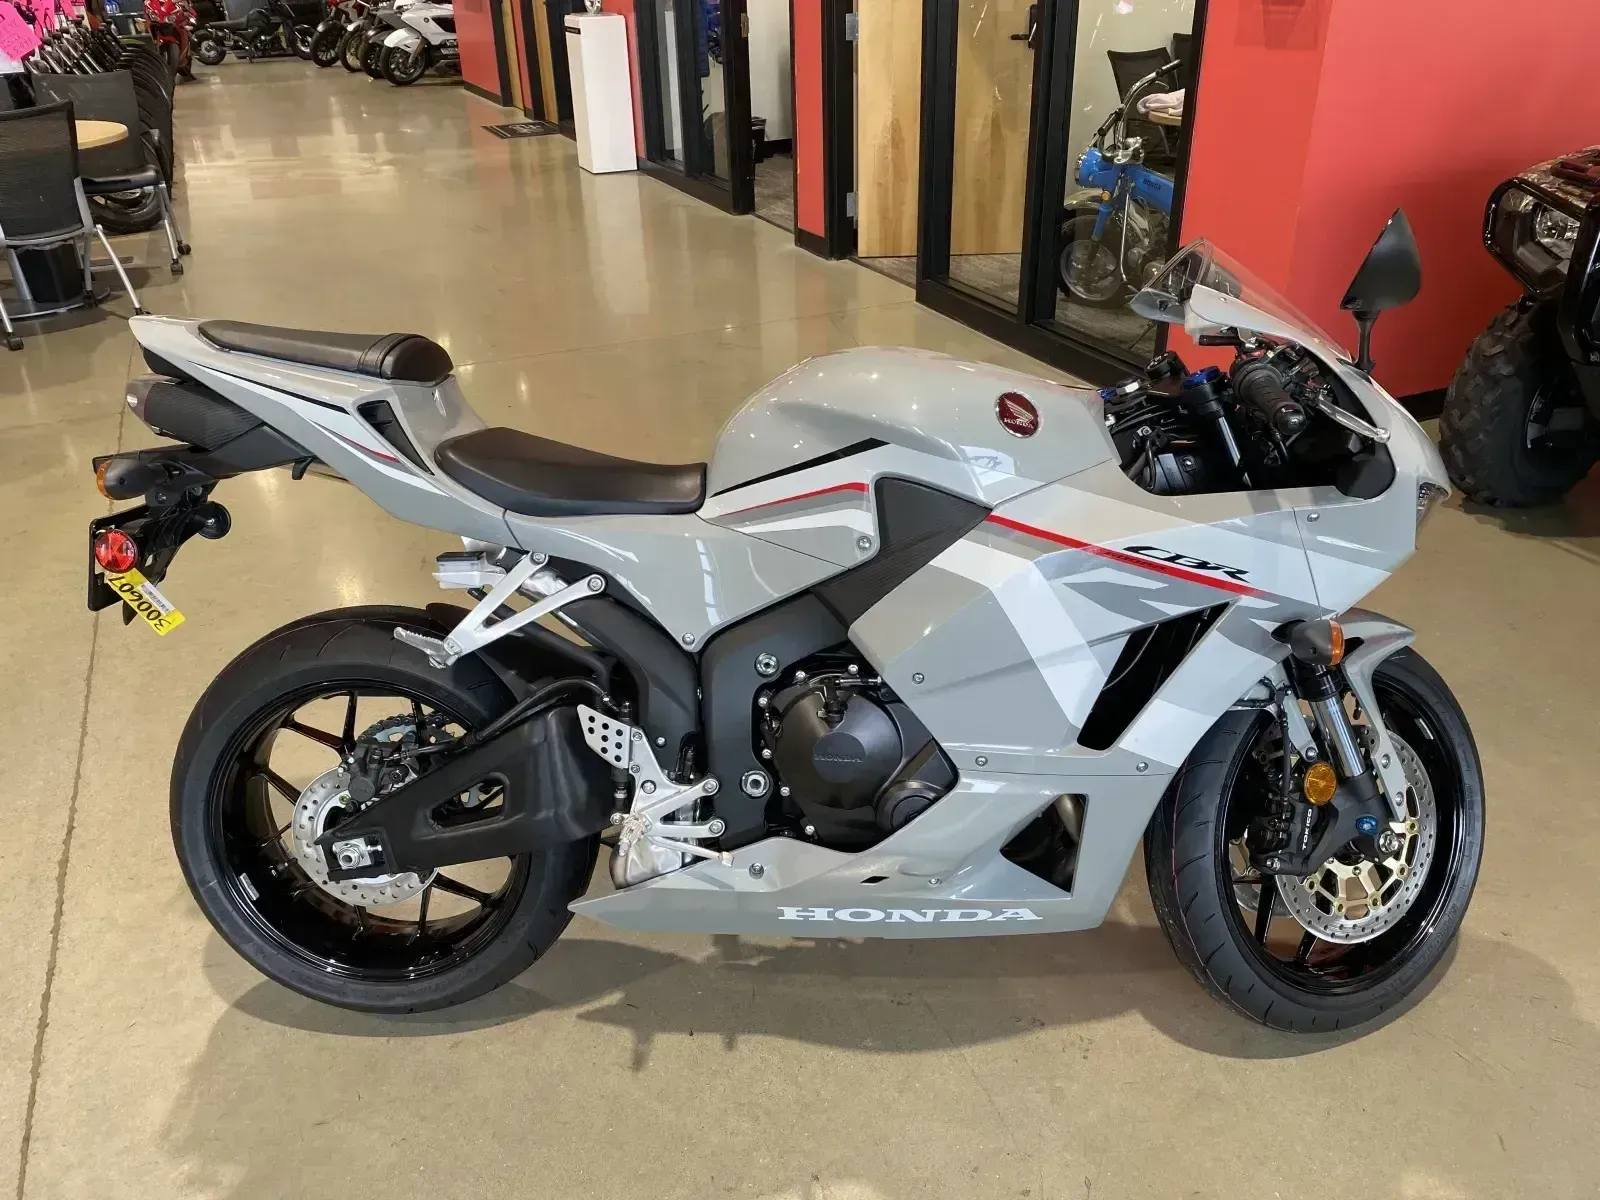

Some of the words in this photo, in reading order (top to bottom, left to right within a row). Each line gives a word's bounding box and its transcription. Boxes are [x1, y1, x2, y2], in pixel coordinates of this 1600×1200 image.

[1003, 417, 1034, 429] HONDA
[1122, 546, 1250, 583] CBR
[107, 576, 172, 632] 300607
[814, 753, 863, 764] HONDA
[1302, 808, 1312, 850] TOKICO
[777, 906, 1043, 922] HONDA
